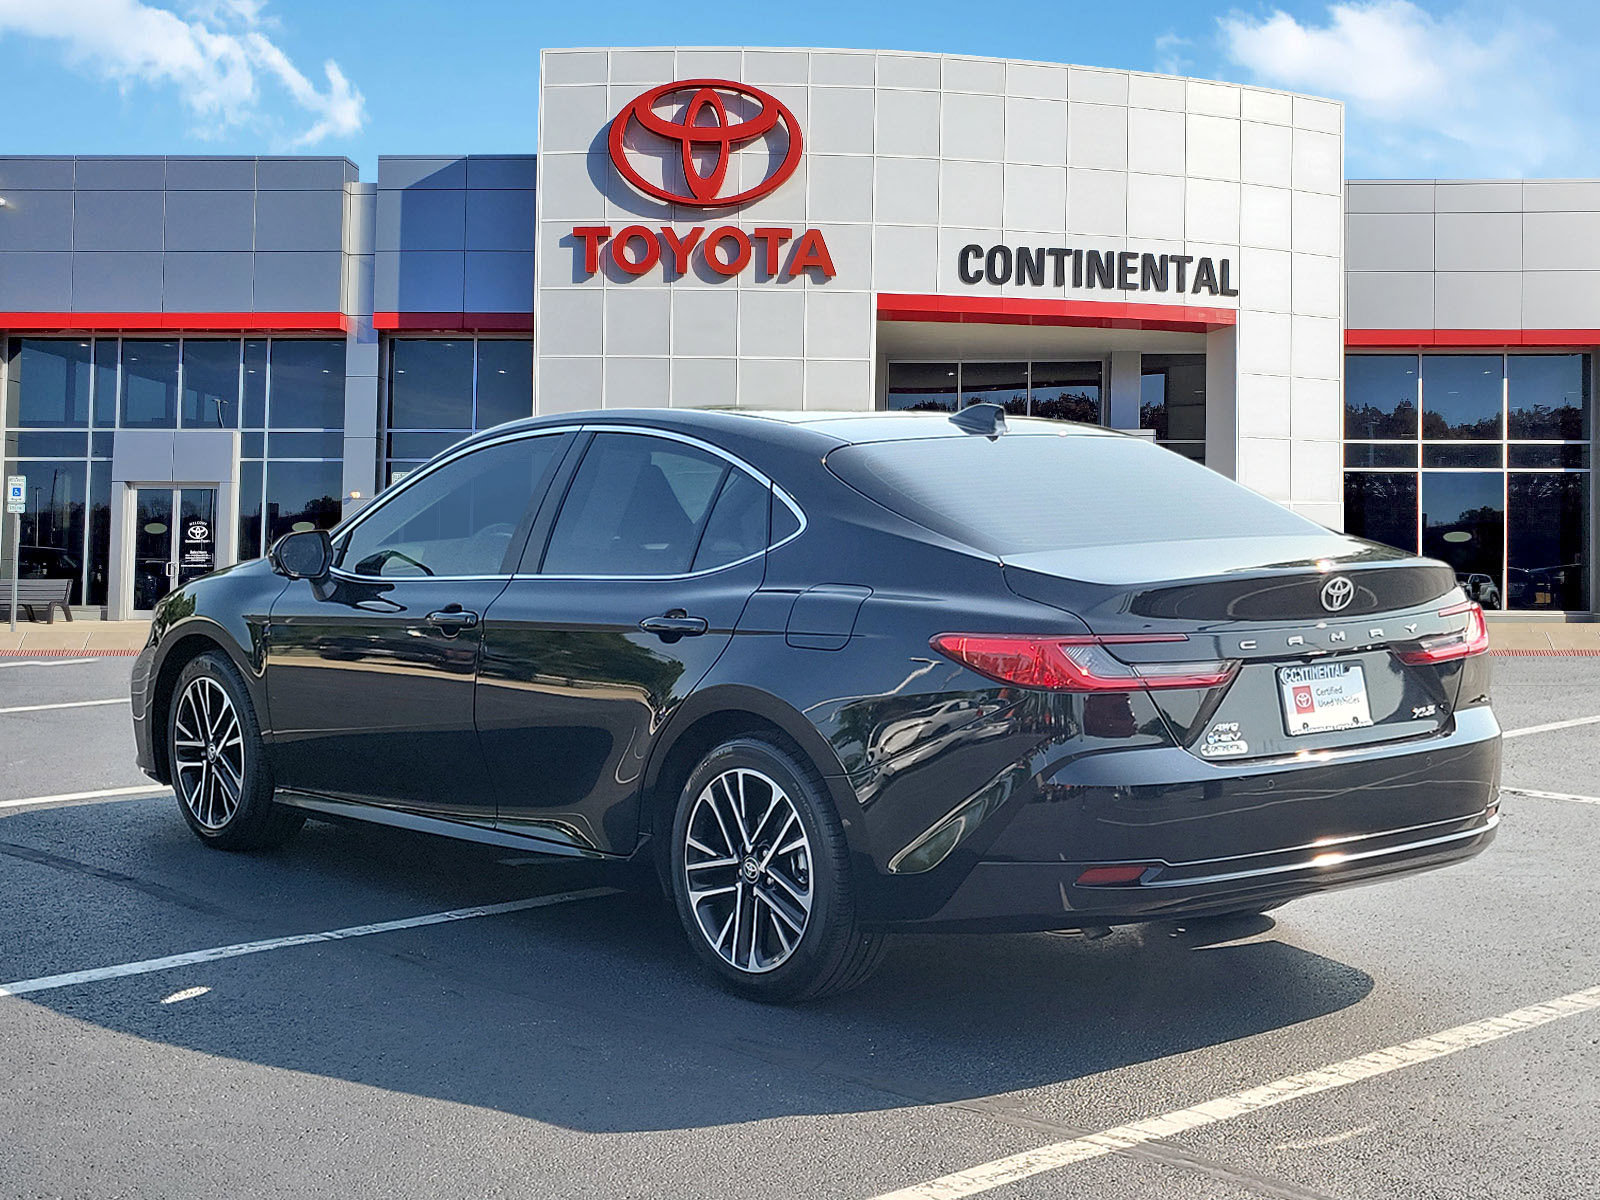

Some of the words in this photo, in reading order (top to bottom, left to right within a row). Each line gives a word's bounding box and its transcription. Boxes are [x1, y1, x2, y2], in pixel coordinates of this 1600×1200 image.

[573, 225, 837, 277] TOYOTA
[958, 244, 1239, 297] CONTINENTAL
[1239, 623, 1418, 650] CAMRY
[1281, 664, 1345, 684] CONTINENTAL
[1316, 686, 1343, 697] Certified
[1317, 697, 1334, 708] Used
[1334, 695, 1361, 706] Vehicles
